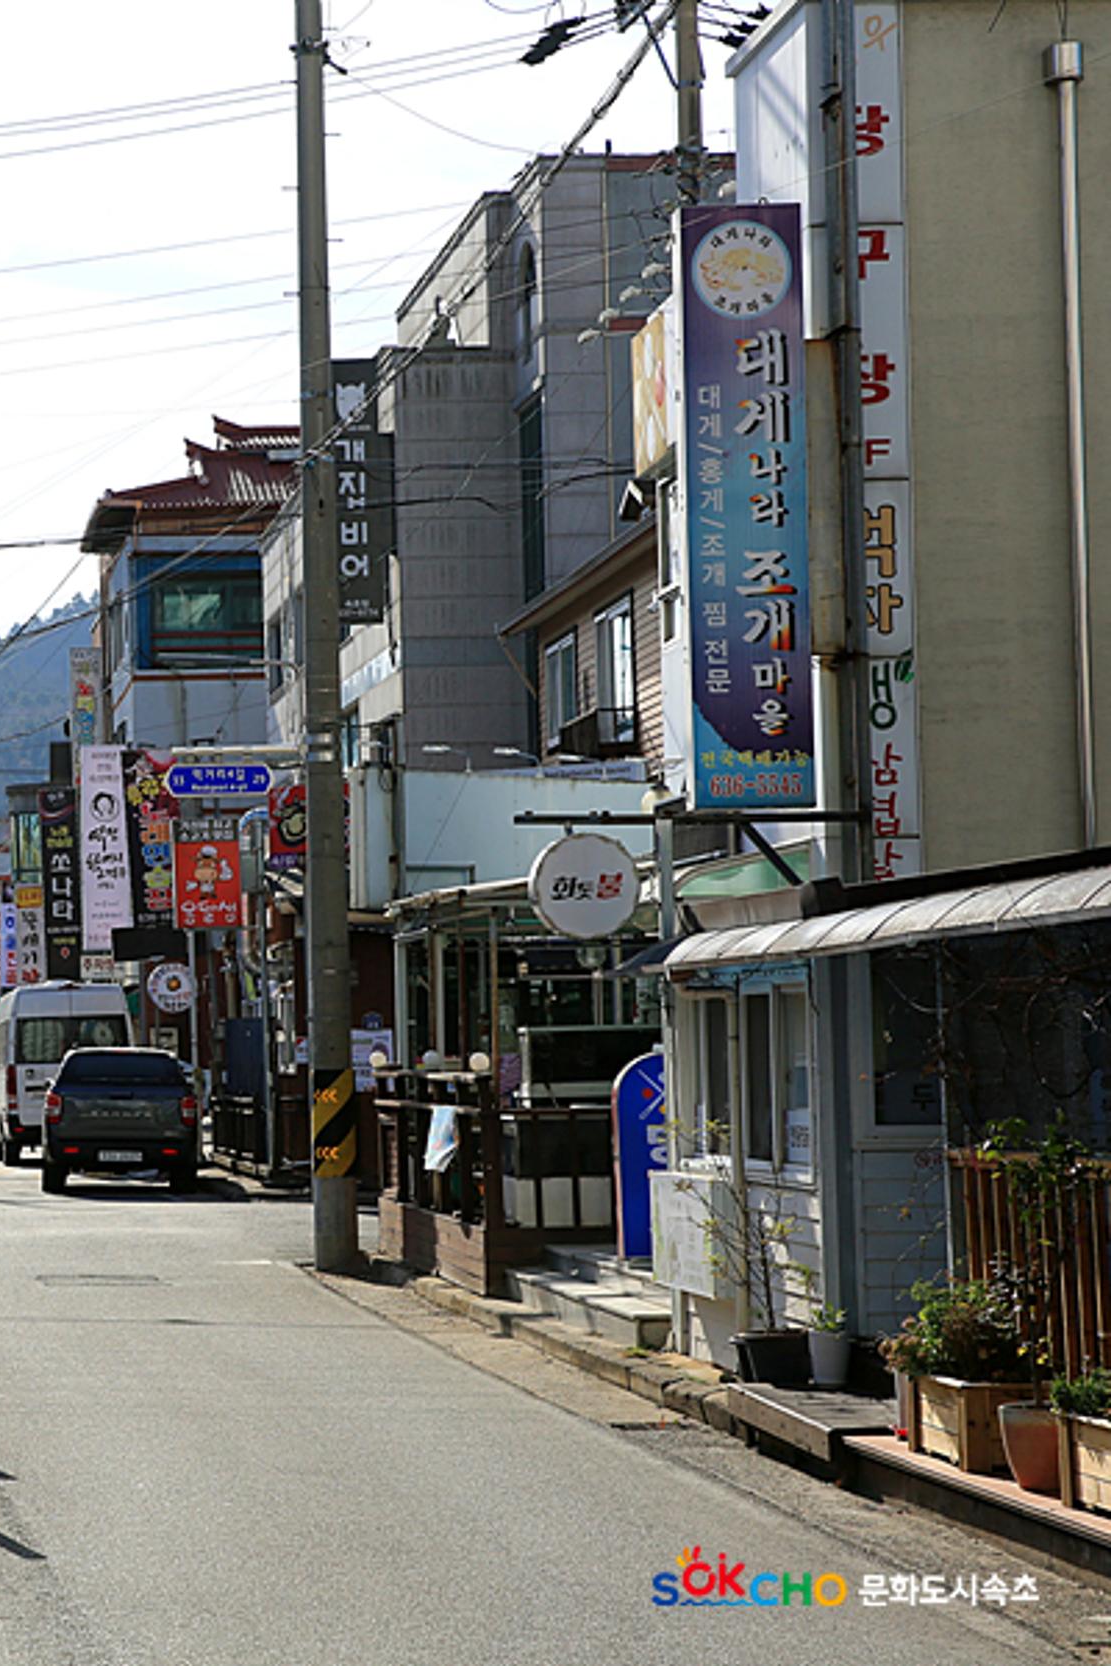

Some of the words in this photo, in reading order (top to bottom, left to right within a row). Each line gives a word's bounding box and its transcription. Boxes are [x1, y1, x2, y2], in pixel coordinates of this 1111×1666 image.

[735, 327, 791, 526] 대게나라
[704, 638, 732, 694] 전문
[735, 550, 798, 736] 조개마을
[710, 774, 802, 797] 636-5545
